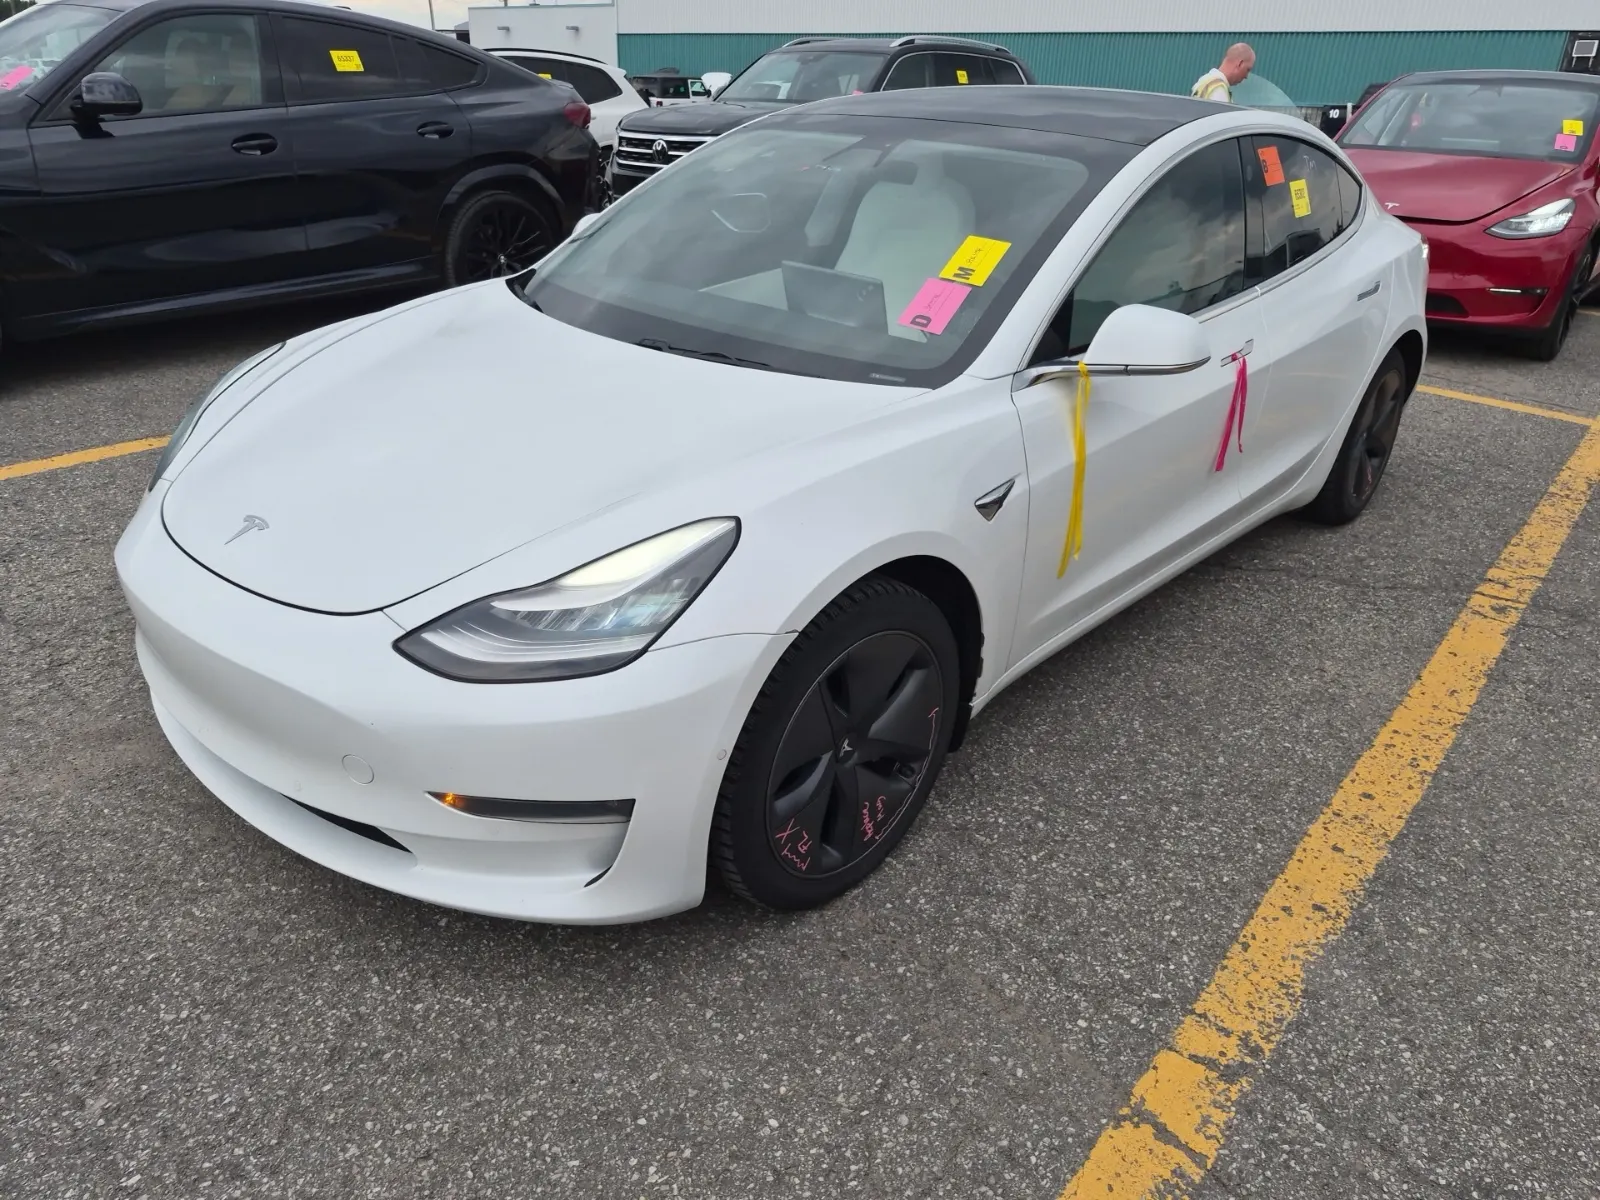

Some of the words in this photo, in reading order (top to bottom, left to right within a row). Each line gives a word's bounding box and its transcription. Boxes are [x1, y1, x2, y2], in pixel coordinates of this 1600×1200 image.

[1329, 109, 1340, 118] 10
[952, 266, 975, 280] M
[910, 315, 932, 328] D
